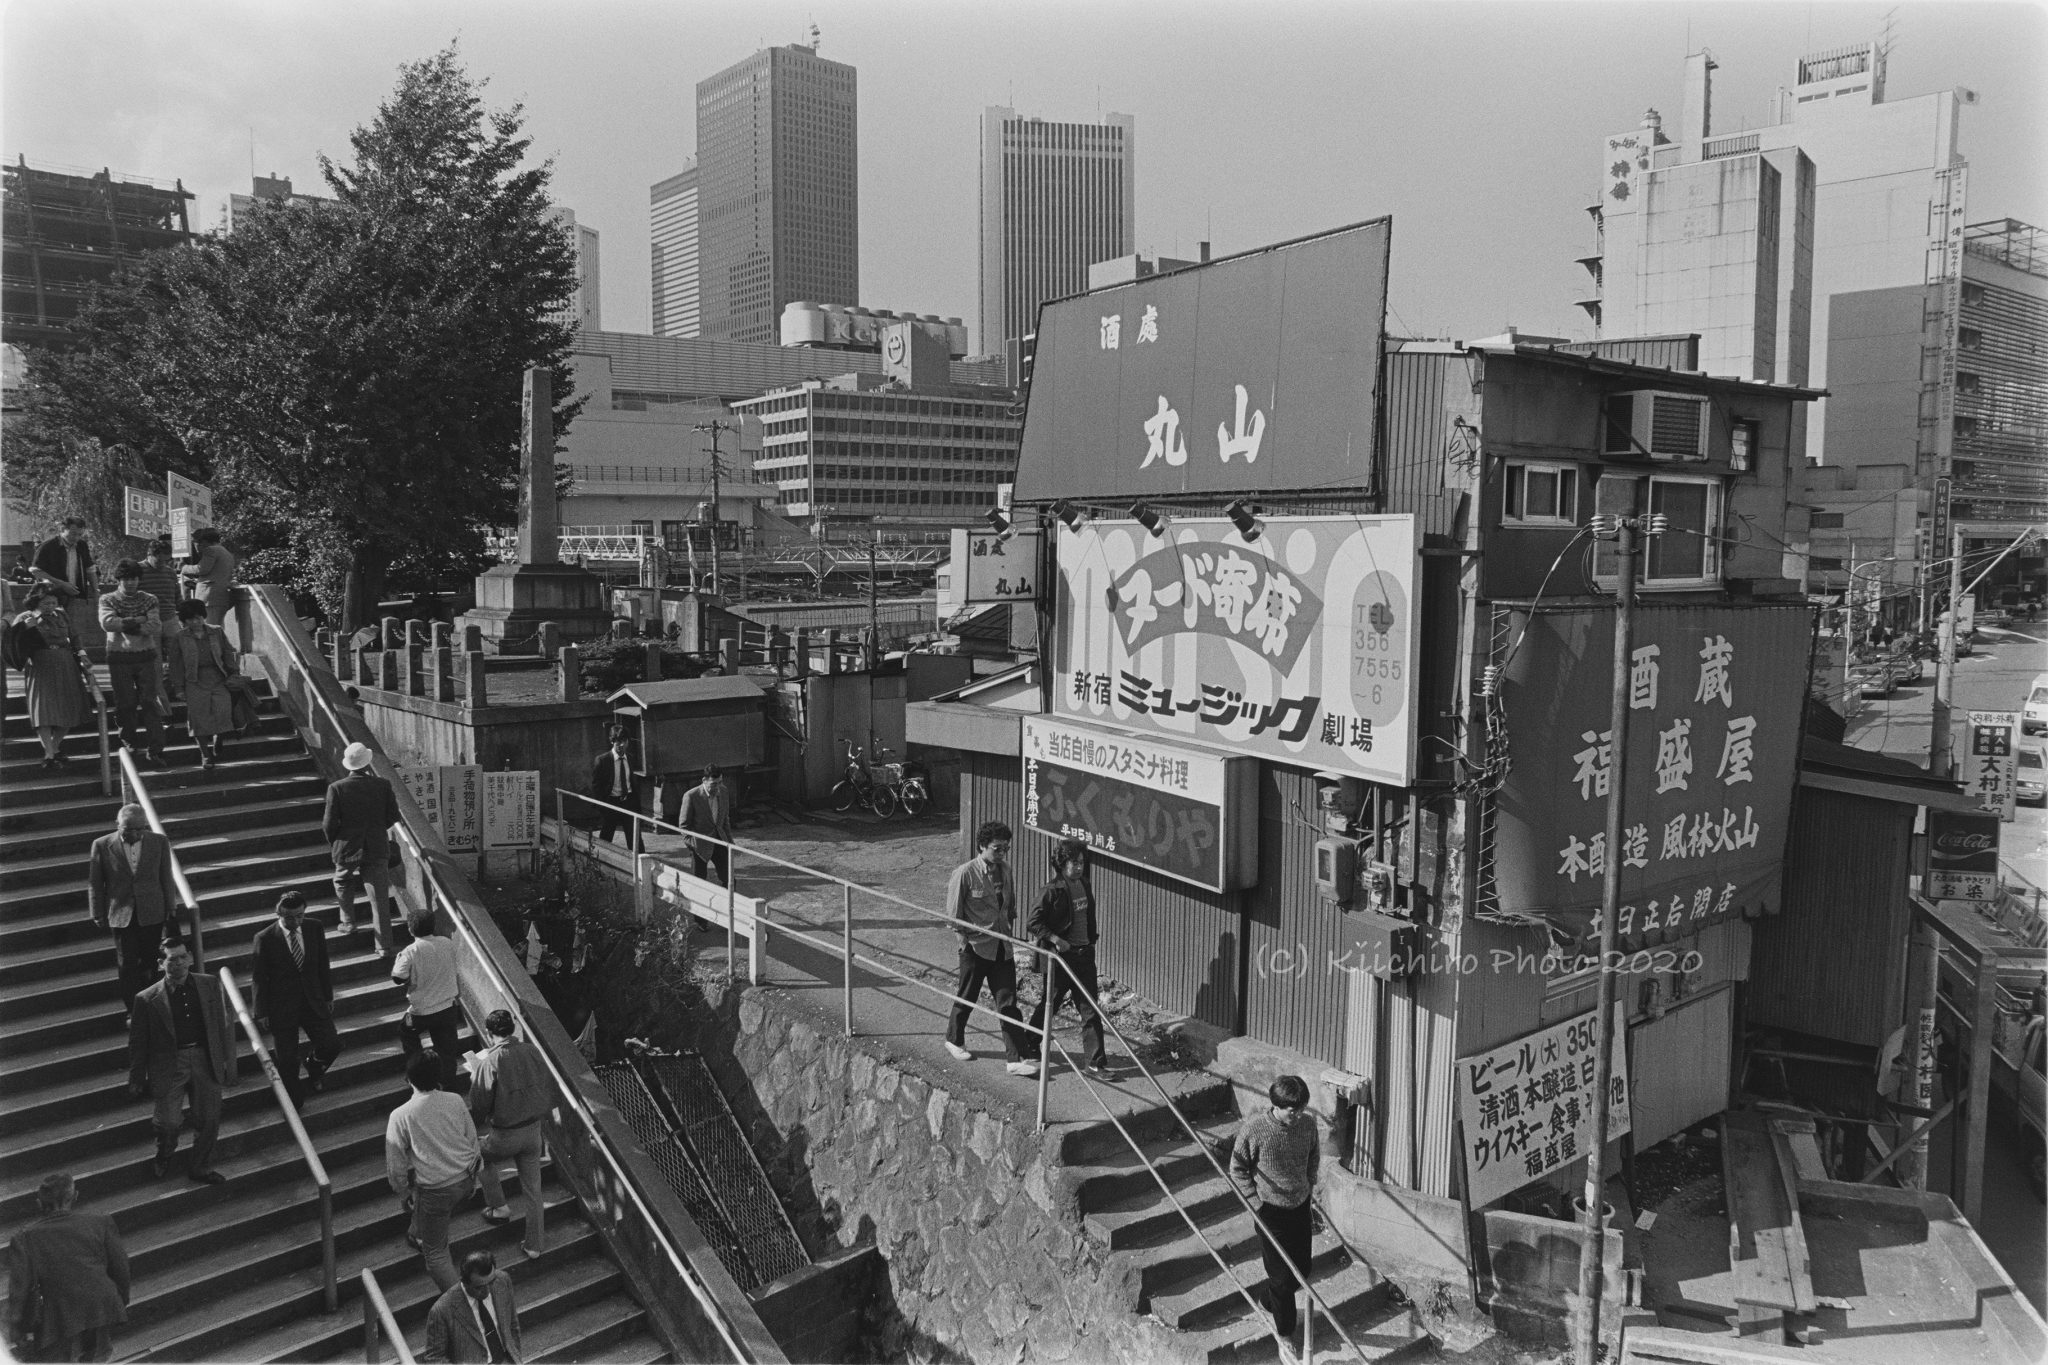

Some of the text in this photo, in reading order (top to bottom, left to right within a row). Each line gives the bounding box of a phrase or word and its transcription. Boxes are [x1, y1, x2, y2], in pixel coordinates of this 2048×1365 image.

[833, 318, 882, 342] Kei
[1139, 384, 1266, 469] 丸山
[1118, 549, 1302, 656] ヌード寄席
[1357, 604, 1391, 625] TEL
[1355, 630, 1389, 651] 356
[1354, 656, 1401, 680] 7555
[1049, 731, 1189, 791] 当店自慢のスタミナ料理
[1979, 757, 2002, 791] 大村
[463, 770, 475, 830] 手荷物預り所
[1042, 768, 1215, 868] ふくもりや
[1660, 805, 1760, 861] 風林火山
[1937, 832, 1993, 848] Coca-Cola
[1524, 1132, 1577, 1178] 福盛屋
